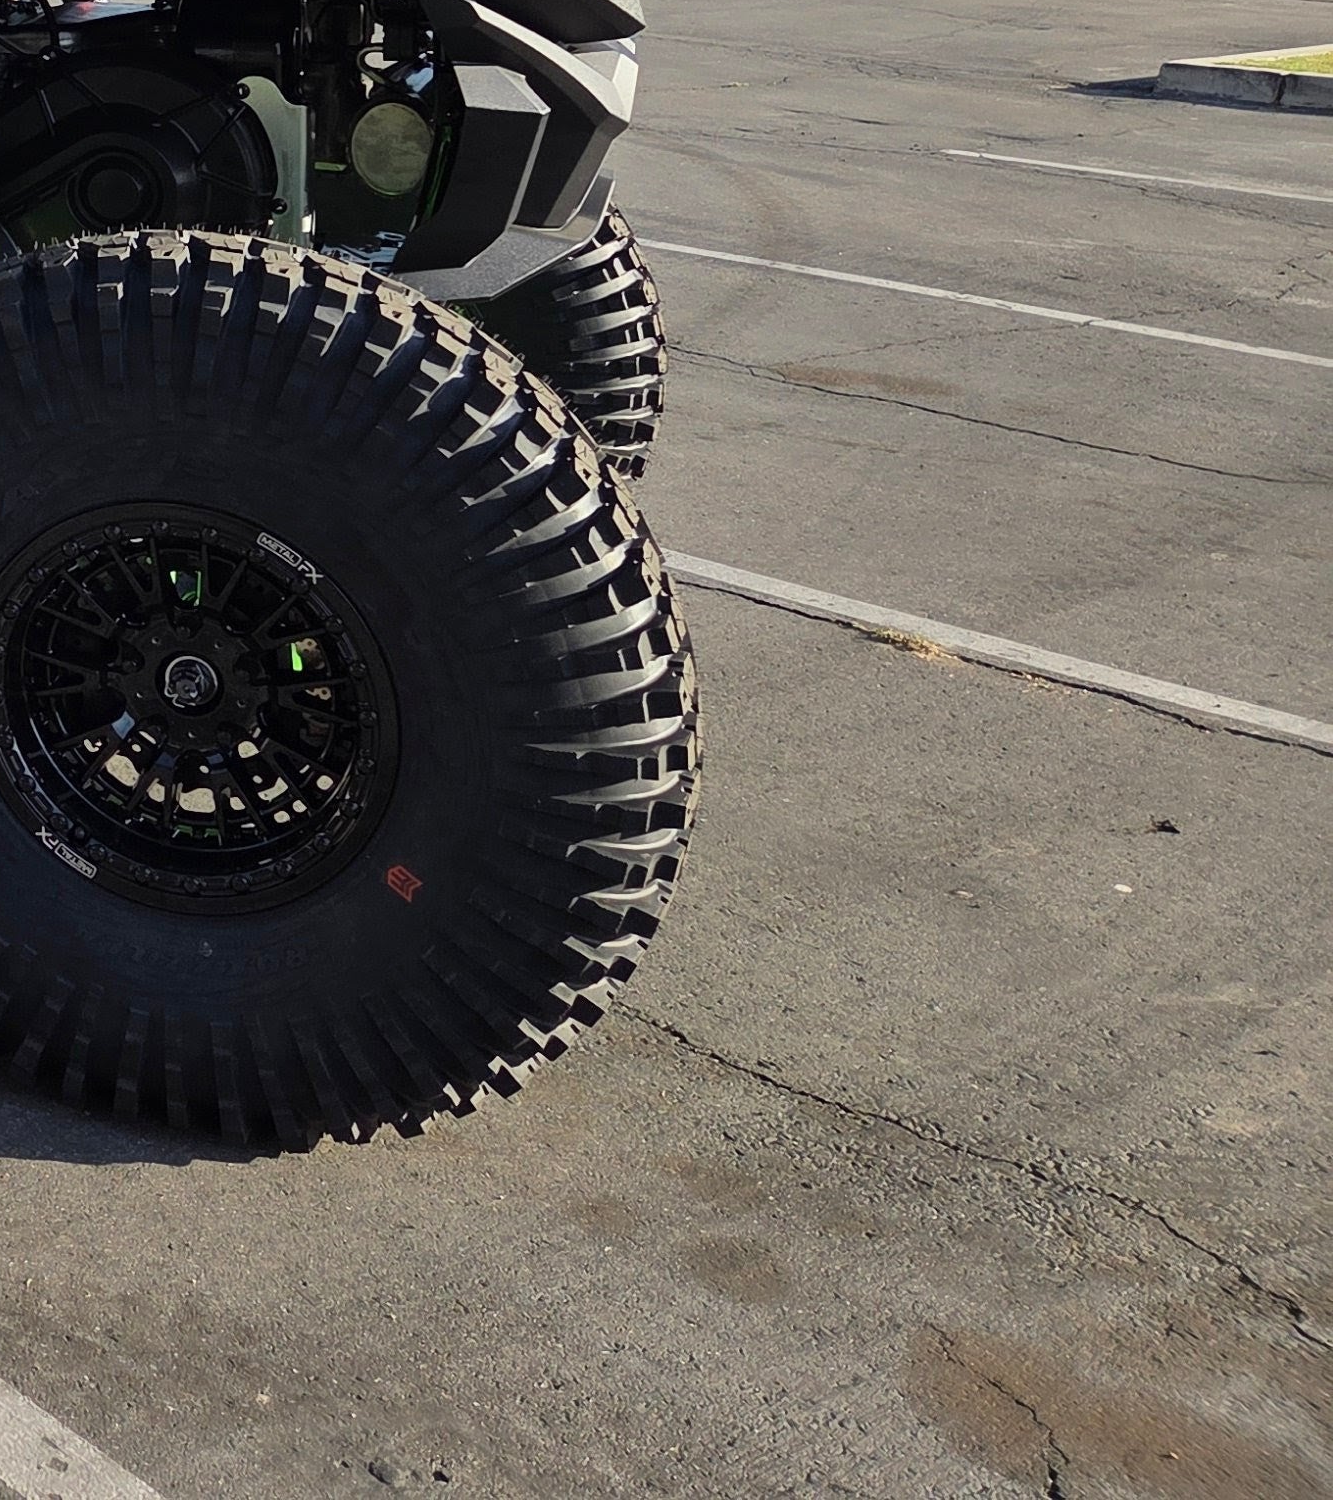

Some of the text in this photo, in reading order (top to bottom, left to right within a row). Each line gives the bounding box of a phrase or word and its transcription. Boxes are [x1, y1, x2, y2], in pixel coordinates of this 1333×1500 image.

[259, 535, 324, 585] METAL FX
[59, 845, 95, 876] METAL
